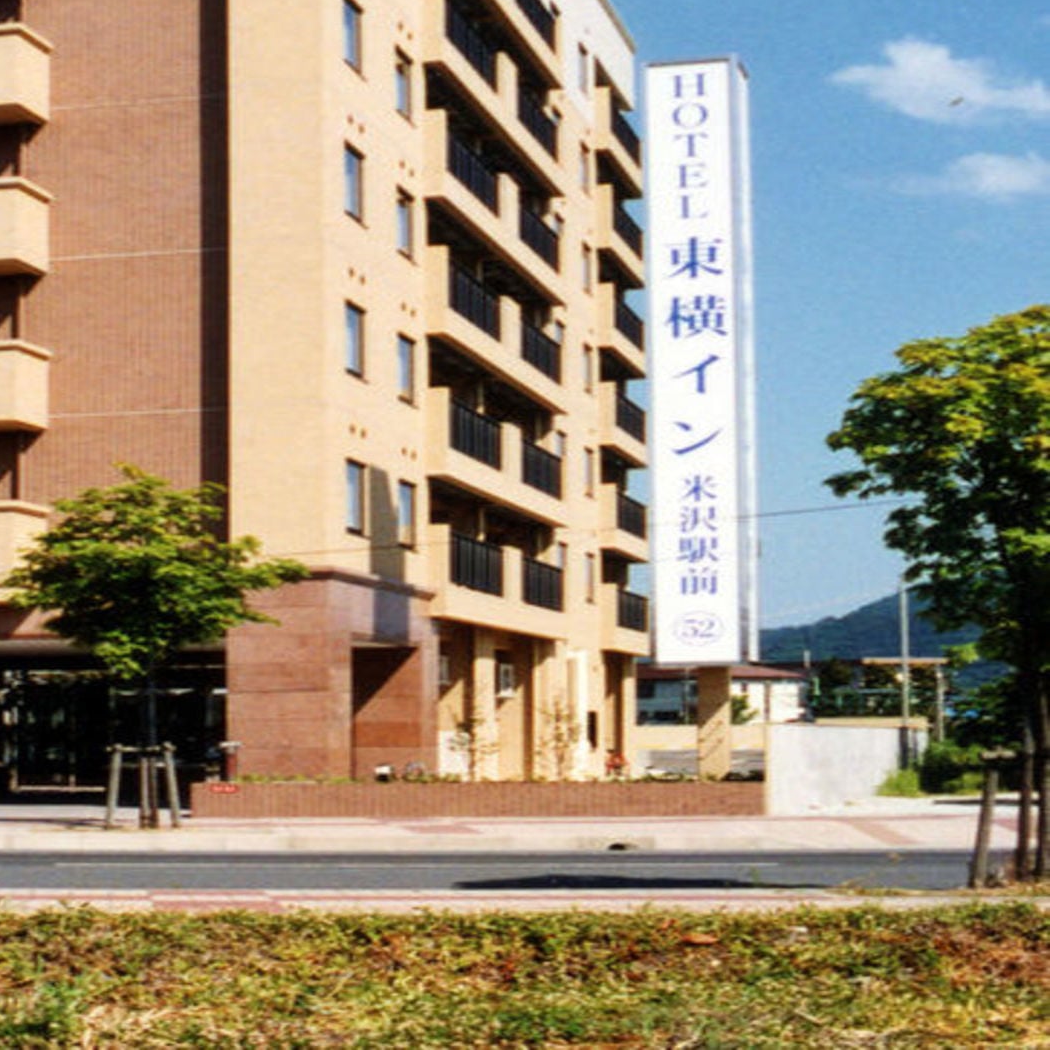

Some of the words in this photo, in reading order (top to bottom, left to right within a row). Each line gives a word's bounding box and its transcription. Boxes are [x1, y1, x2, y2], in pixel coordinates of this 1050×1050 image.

[672, 72, 709, 220] HOTEL
[663, 236, 728, 456] 東横イン
[677, 474, 718, 596] 米沢駅前
